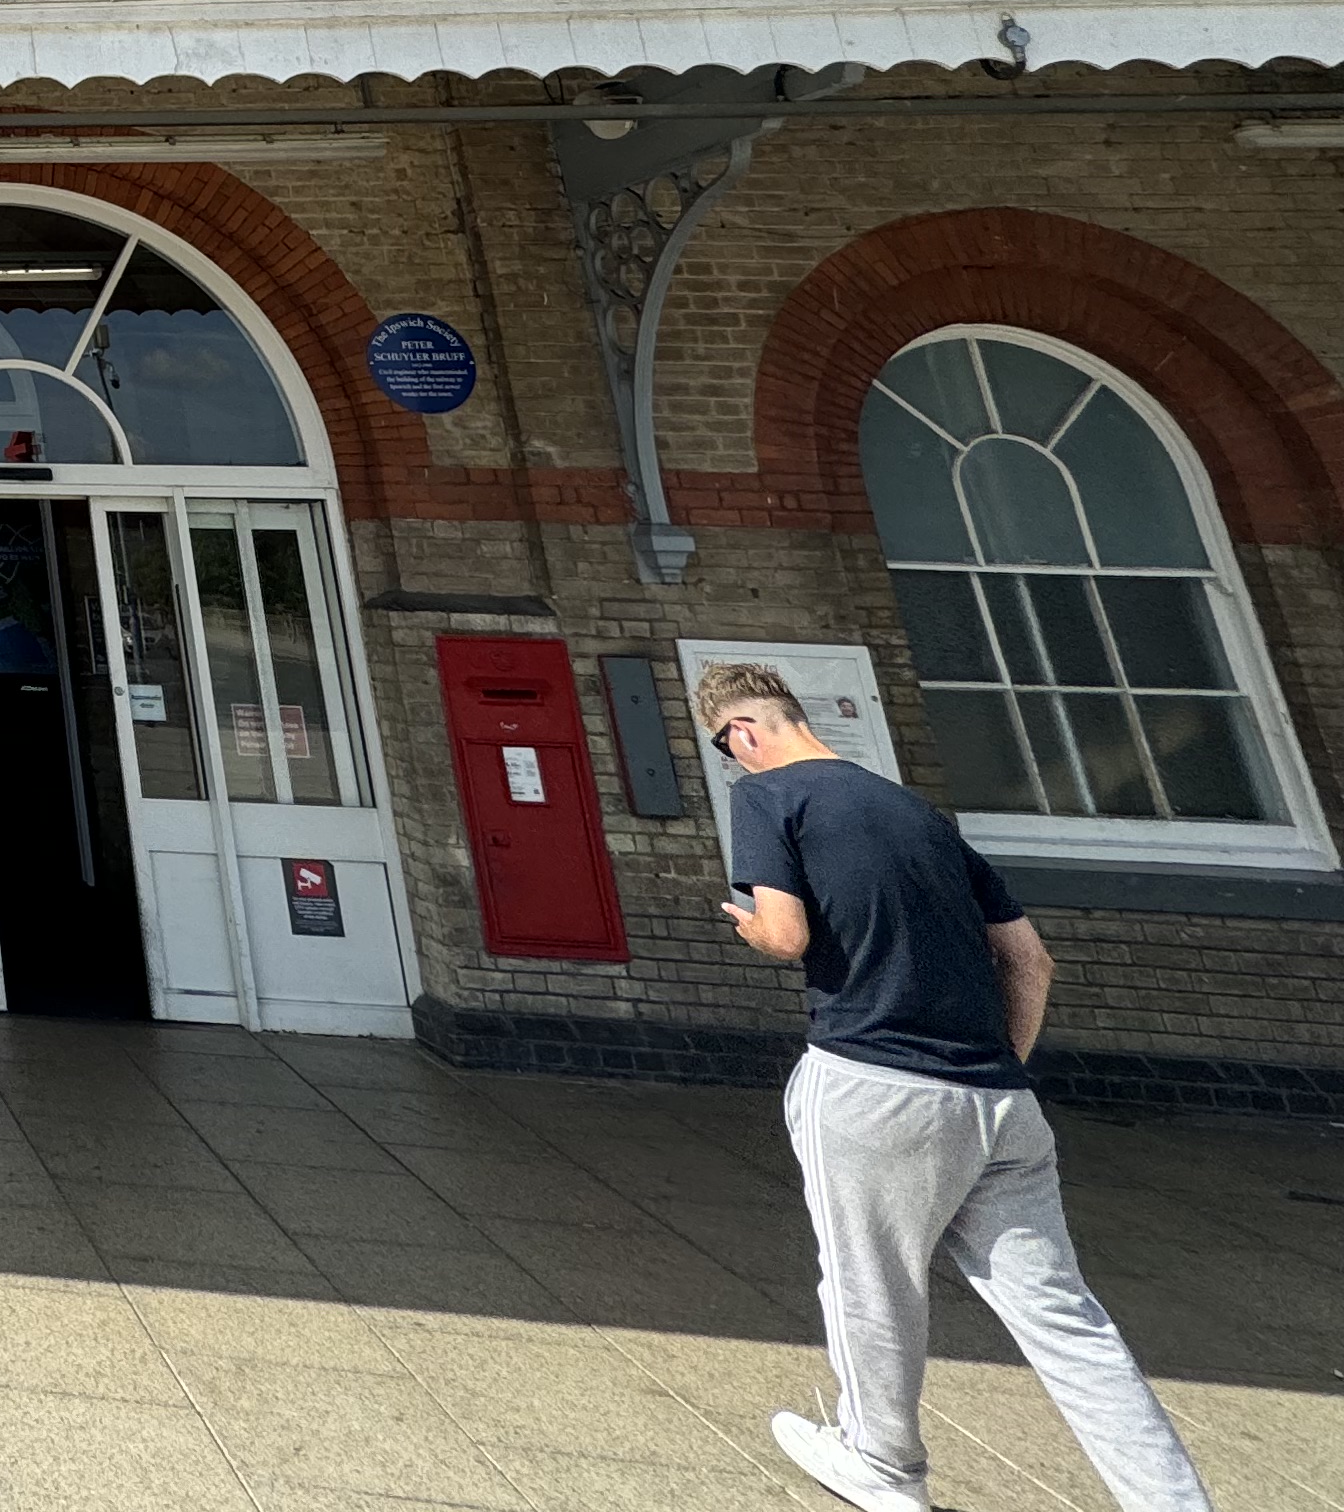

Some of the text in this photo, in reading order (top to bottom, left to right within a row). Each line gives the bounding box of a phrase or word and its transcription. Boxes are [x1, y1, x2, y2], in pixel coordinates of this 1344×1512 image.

[372, 317, 461, 346] The Ipswich Society
[401, 340, 434, 350] PETER
[374, 352, 466, 362] SCHUYLER BRUFF
